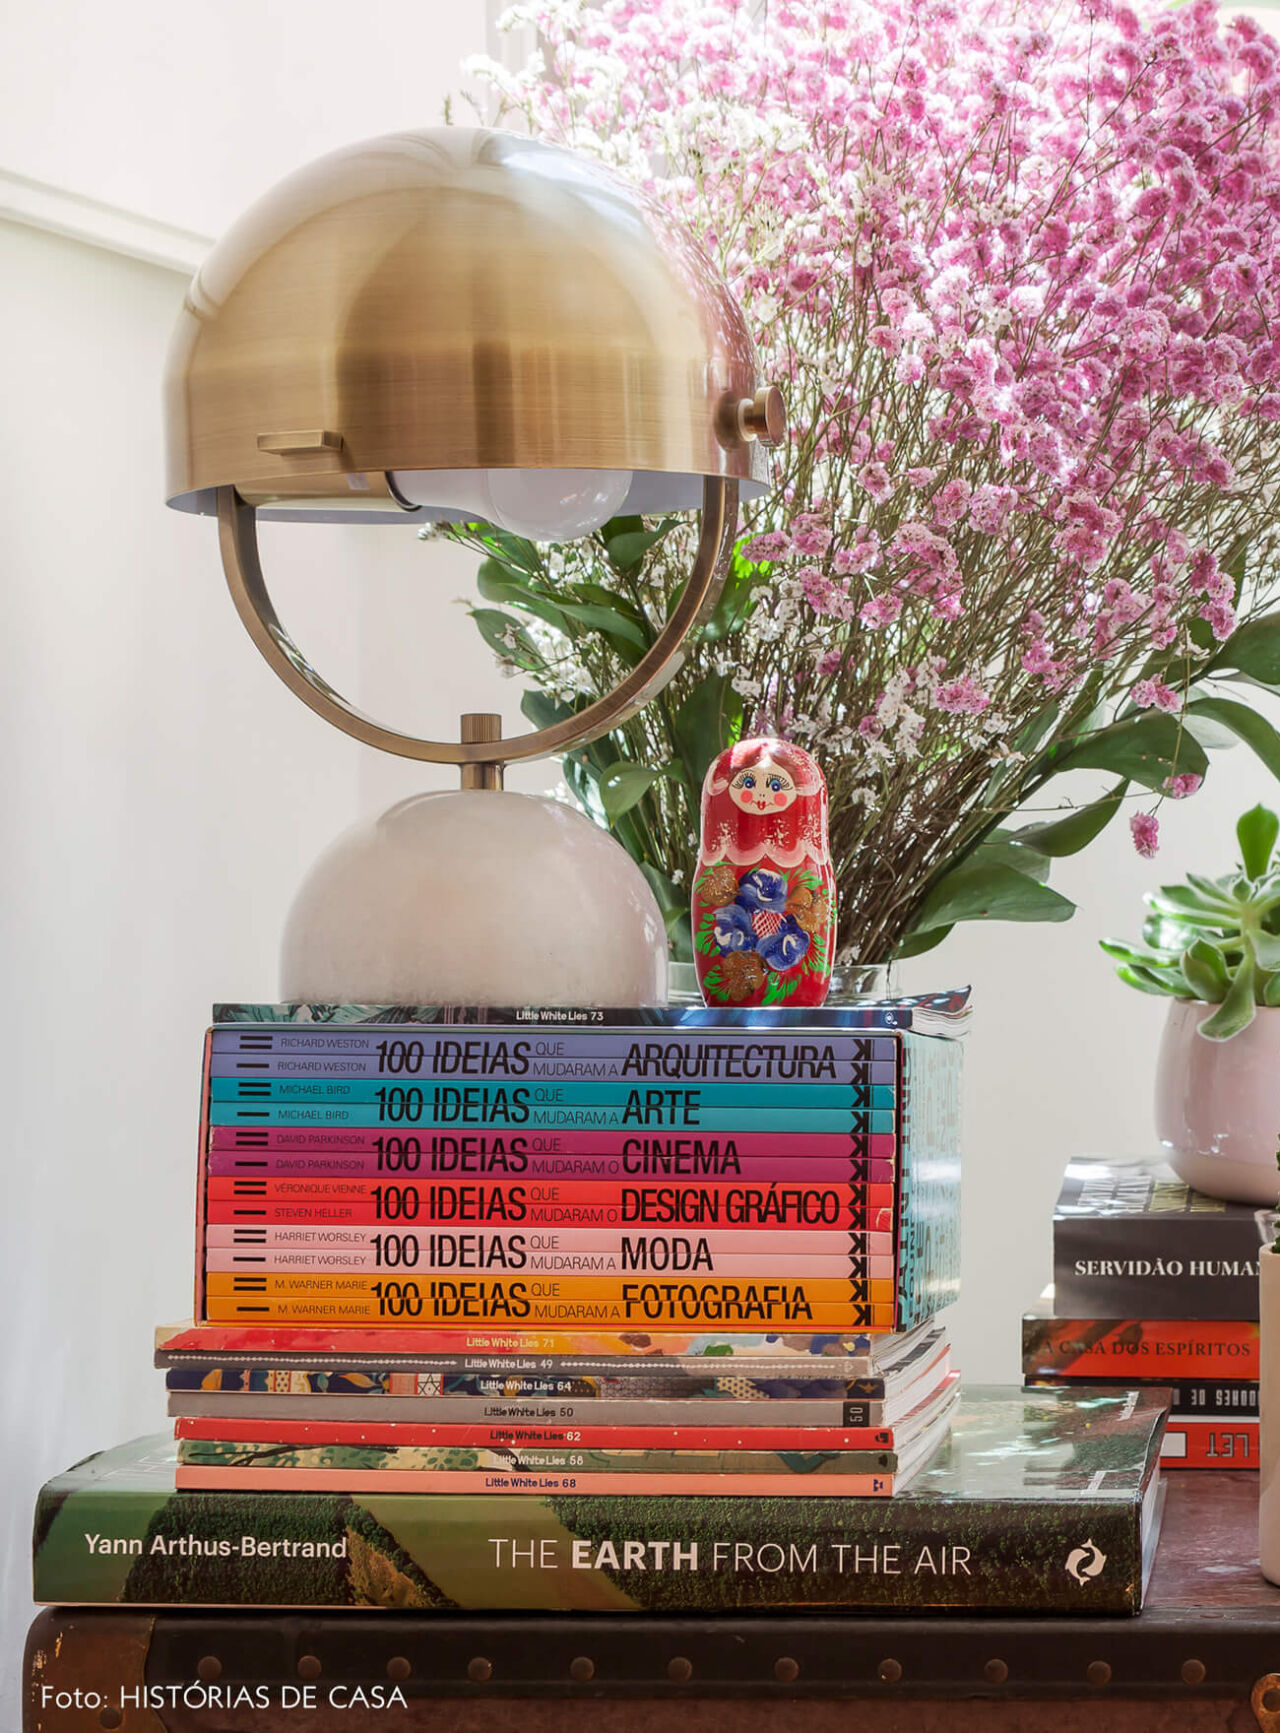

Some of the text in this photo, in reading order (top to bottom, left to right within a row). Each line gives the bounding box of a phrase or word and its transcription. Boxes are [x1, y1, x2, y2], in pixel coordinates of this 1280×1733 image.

[516, 1010, 604, 1021] Little White Lies 73
[280, 1037, 369, 1049] RICHARD WESTON
[535, 1042, 565, 1056] QUE
[376, 1040, 531, 1075] 100 IDEIAS
[621, 1043, 837, 1079] ARQUITECTURA
[277, 1061, 366, 1072] RICHARD WESTON
[533, 1063, 619, 1076] MUDARAM A
[279, 1085, 350, 1095] MICHAEL BIRD
[534, 1088, 564, 1102] QUE
[374, 1086, 530, 1123] 100 IDEIAS
[622, 1089, 701, 1125] ARTE
[278, 1110, 349, 1120] MICHAEL BIRD
[534, 1111, 619, 1125] MUDARAM A
[277, 1135, 365, 1145] DAVID PARKINSON
[532, 1138, 561, 1151] QUE
[372, 1137, 528, 1173] 100 IDEIAS
[622, 1139, 741, 1175] CINEMA
[275, 1159, 365, 1170] DAVID PARKINSON
[532, 1160, 619, 1174] MUDARAM O
[274, 1182, 367, 1194] VÉRONIQUE VIENNE
[530, 1187, 559, 1201] QUE
[370, 1186, 527, 1221] 100 IDEIAS
[621, 1182, 840, 1224] DESIGN GRÁFICO
[274, 1208, 352, 1218] STEVEN HELLER
[531, 1208, 618, 1222] MUDARAM O
[274, 1232, 366, 1242] HARRIET WORSLEY
[530, 1236, 559, 1249] QUE
[370, 1234, 527, 1268] 100 IDEIAS
[621, 1237, 714, 1271] MODA
[274, 1255, 367, 1265] HARRIET WORSLEY
[531, 1256, 616, 1270] MUDARAM A
[1074, 1257, 1184, 1276] SERVIDÃO
[289, 1280, 333, 1289] WARNER
[335, 1281, 367, 1290] MARIE
[531, 1283, 560, 1297] QUE
[371, 1281, 530, 1318] 100 IDEIAS
[622, 1284, 813, 1320] FOTOGRAFIA
[292, 1305, 336, 1315] WARNER
[338, 1306, 371, 1315] MARIE
[534, 1305, 620, 1319] MUDARAM A
[466, 1337, 554, 1348] Little White Lies 71
[1112, 1341, 1149, 1355] DOS
[1156, 1339, 1251, 1356] ESPÍRITOS
[465, 1359, 553, 1369] Little White Lies 49
[480, 1380, 572, 1391] Little White Lies 64
[484, 1407, 573, 1417] Little White Lies 50
[490, 1430, 581, 1441] Little White Lies 62
[493, 1455, 583, 1465] Little White Lies 58
[485, 1478, 576, 1487] Little White Lies 68
[84, 1533, 348, 1558] Yann Arthus-Bertrand
[488, 1538, 972, 1576] THE EARTH FROM THE AIR
